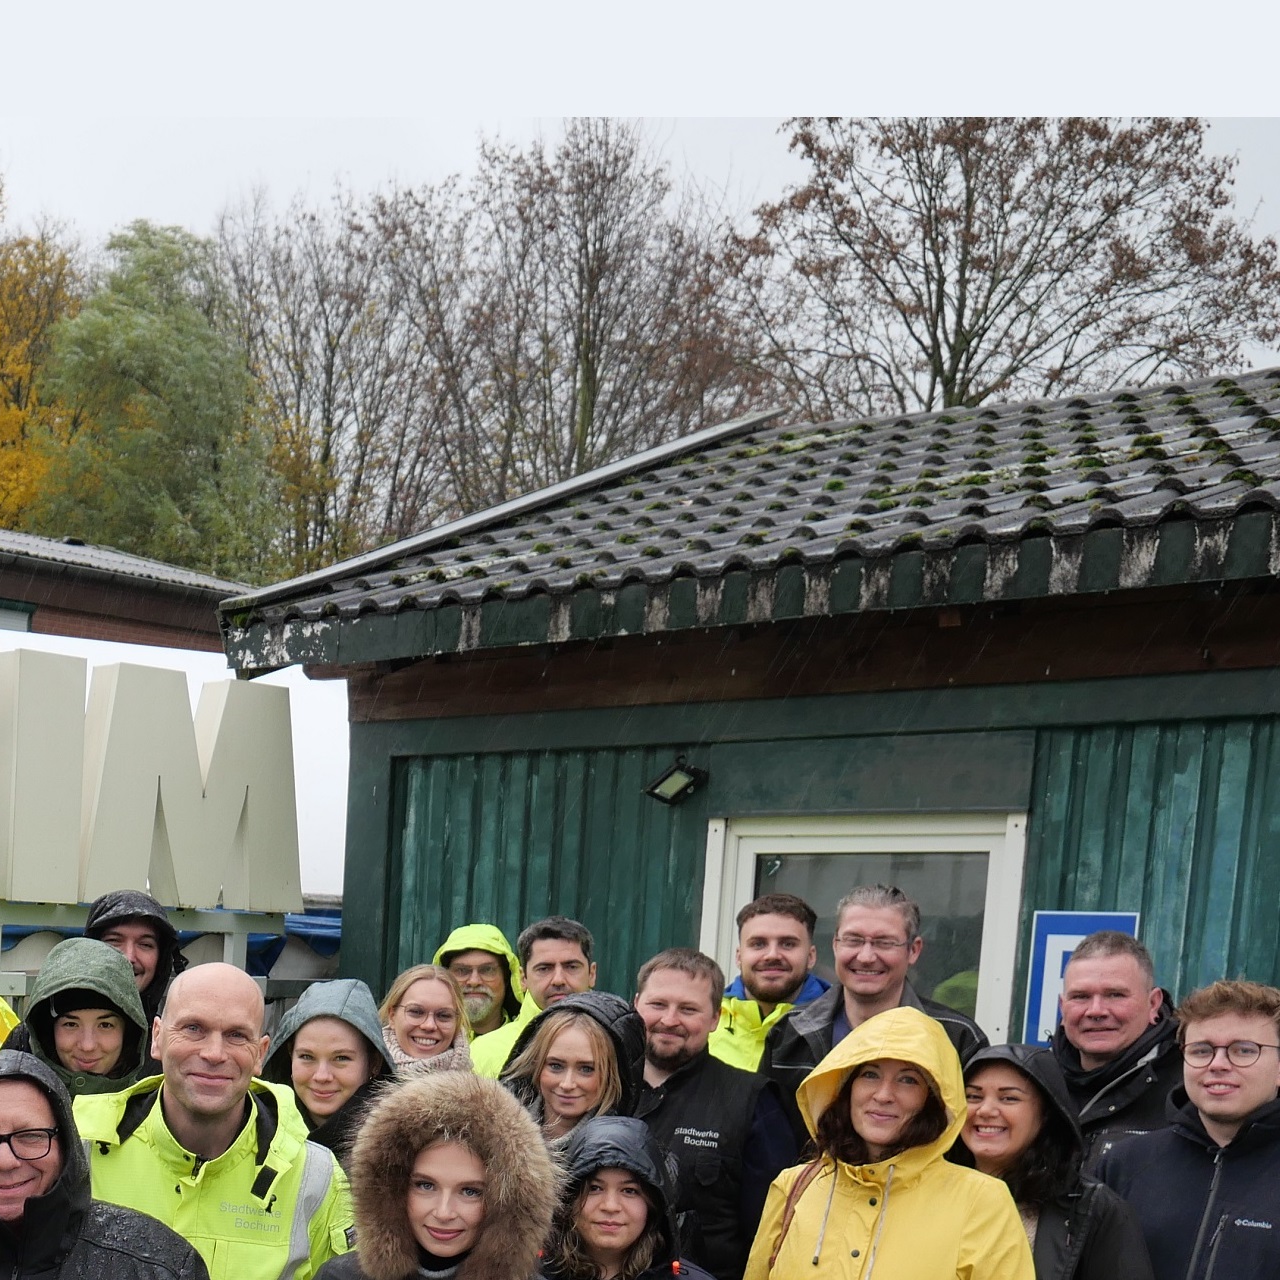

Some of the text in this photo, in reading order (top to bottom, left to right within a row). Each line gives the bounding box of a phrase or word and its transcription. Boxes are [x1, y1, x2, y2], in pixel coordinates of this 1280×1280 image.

[674, 1127, 720, 1139] Stadtwerke
[684, 1136, 718, 1148] Bochum
[234, 1217, 280, 1233] Bochum
